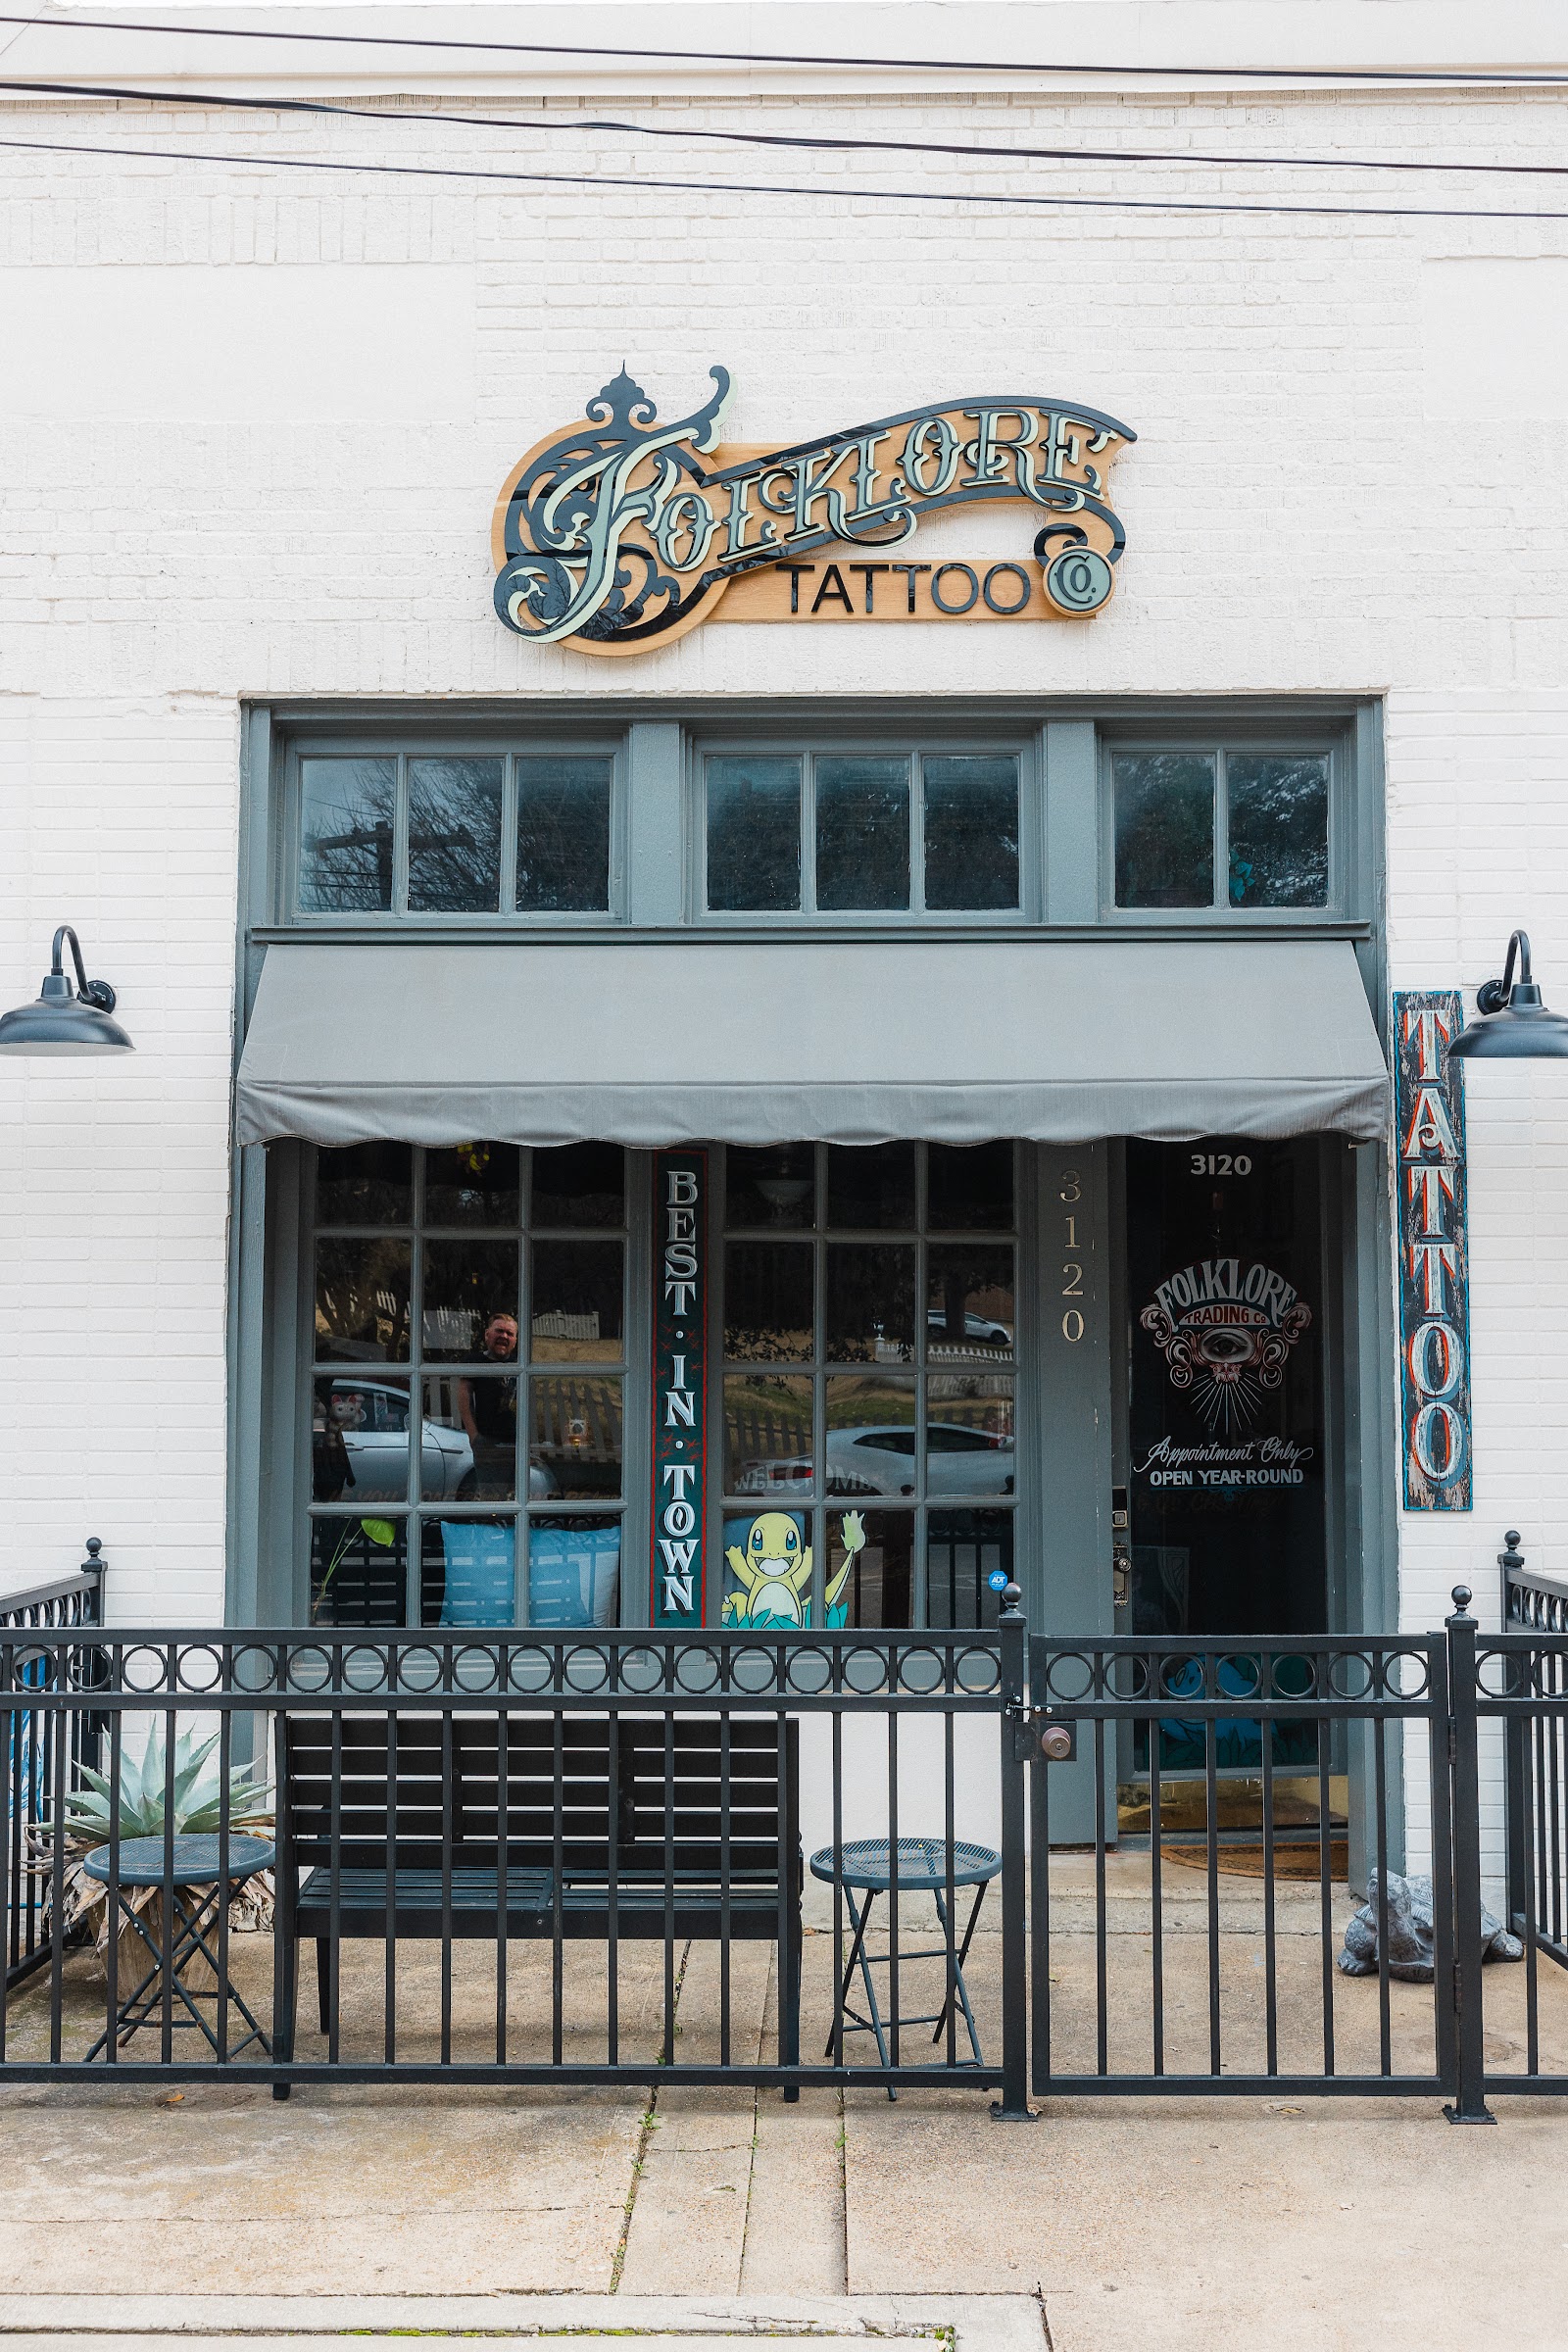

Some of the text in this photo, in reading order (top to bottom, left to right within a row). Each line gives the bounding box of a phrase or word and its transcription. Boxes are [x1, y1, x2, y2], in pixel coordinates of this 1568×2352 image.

[494, 367, 1117, 644] FOLKLORE
[775, 563, 1030, 614] TATTOO
[1190, 1153, 1252, 1176] 3120
[1059, 1170, 1085, 1343] 3120
[1402, 1008, 1465, 1486] TATTOO
[1153, 1257, 1298, 1331] FOLKLORE
[1183, 1304, 1250, 1325] TRADING
[658, 1170, 701, 1612] BEST IN TOWN
[1133, 1435, 1314, 1473] Appointment Only
[1149, 1468, 1304, 1487] OPEN YEAR-ROUND
